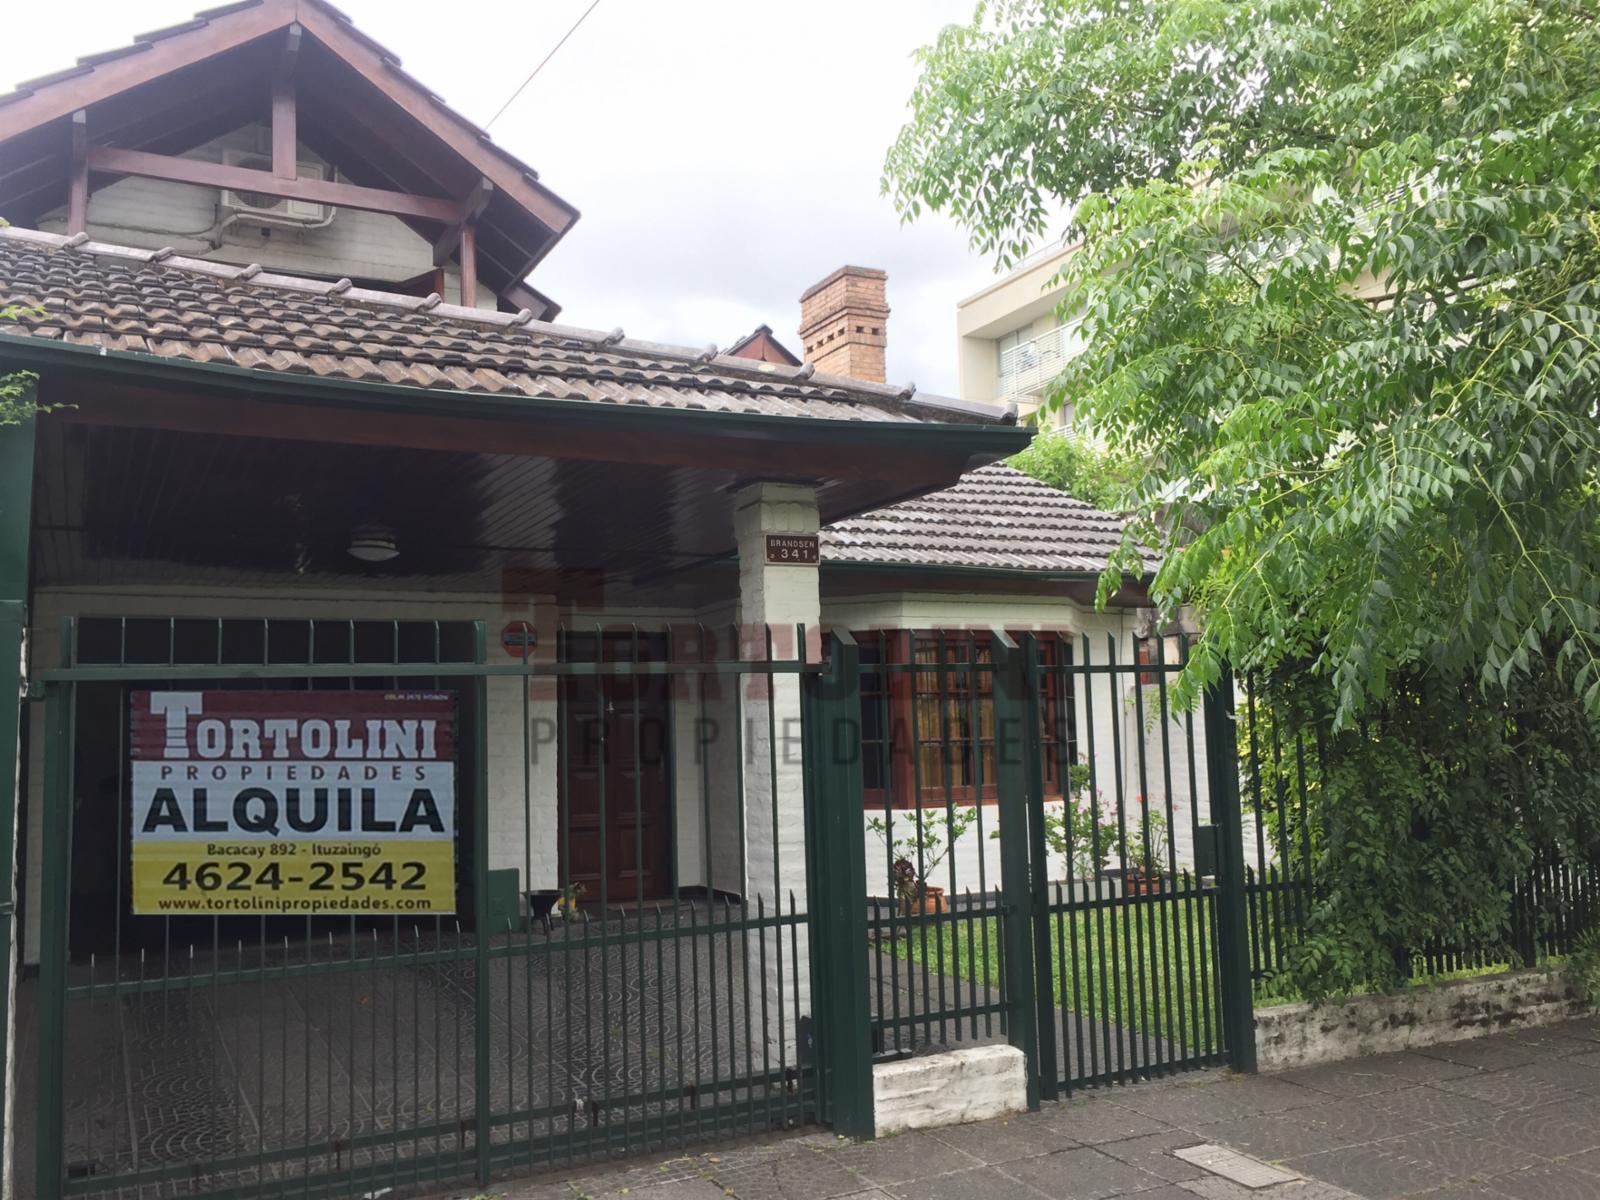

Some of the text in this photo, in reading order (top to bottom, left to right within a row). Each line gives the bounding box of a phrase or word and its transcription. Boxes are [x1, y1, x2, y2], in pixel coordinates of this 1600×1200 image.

[770, 539, 815, 549] BRANDSEN
[780, 548, 808, 559] 341
[150, 691, 437, 759] TORTOLINI
[160, 765, 426, 781] PROPIEDADES
[142, 787, 446, 837] ALQUILA
[207, 844, 265, 858] Bacacay
[270, 843, 297, 856] 892
[312, 843, 381, 858] Ituzaingó
[162, 862, 427, 891] 4624-2542
[158, 897, 431, 913] www.tortolinipropiedades.com
